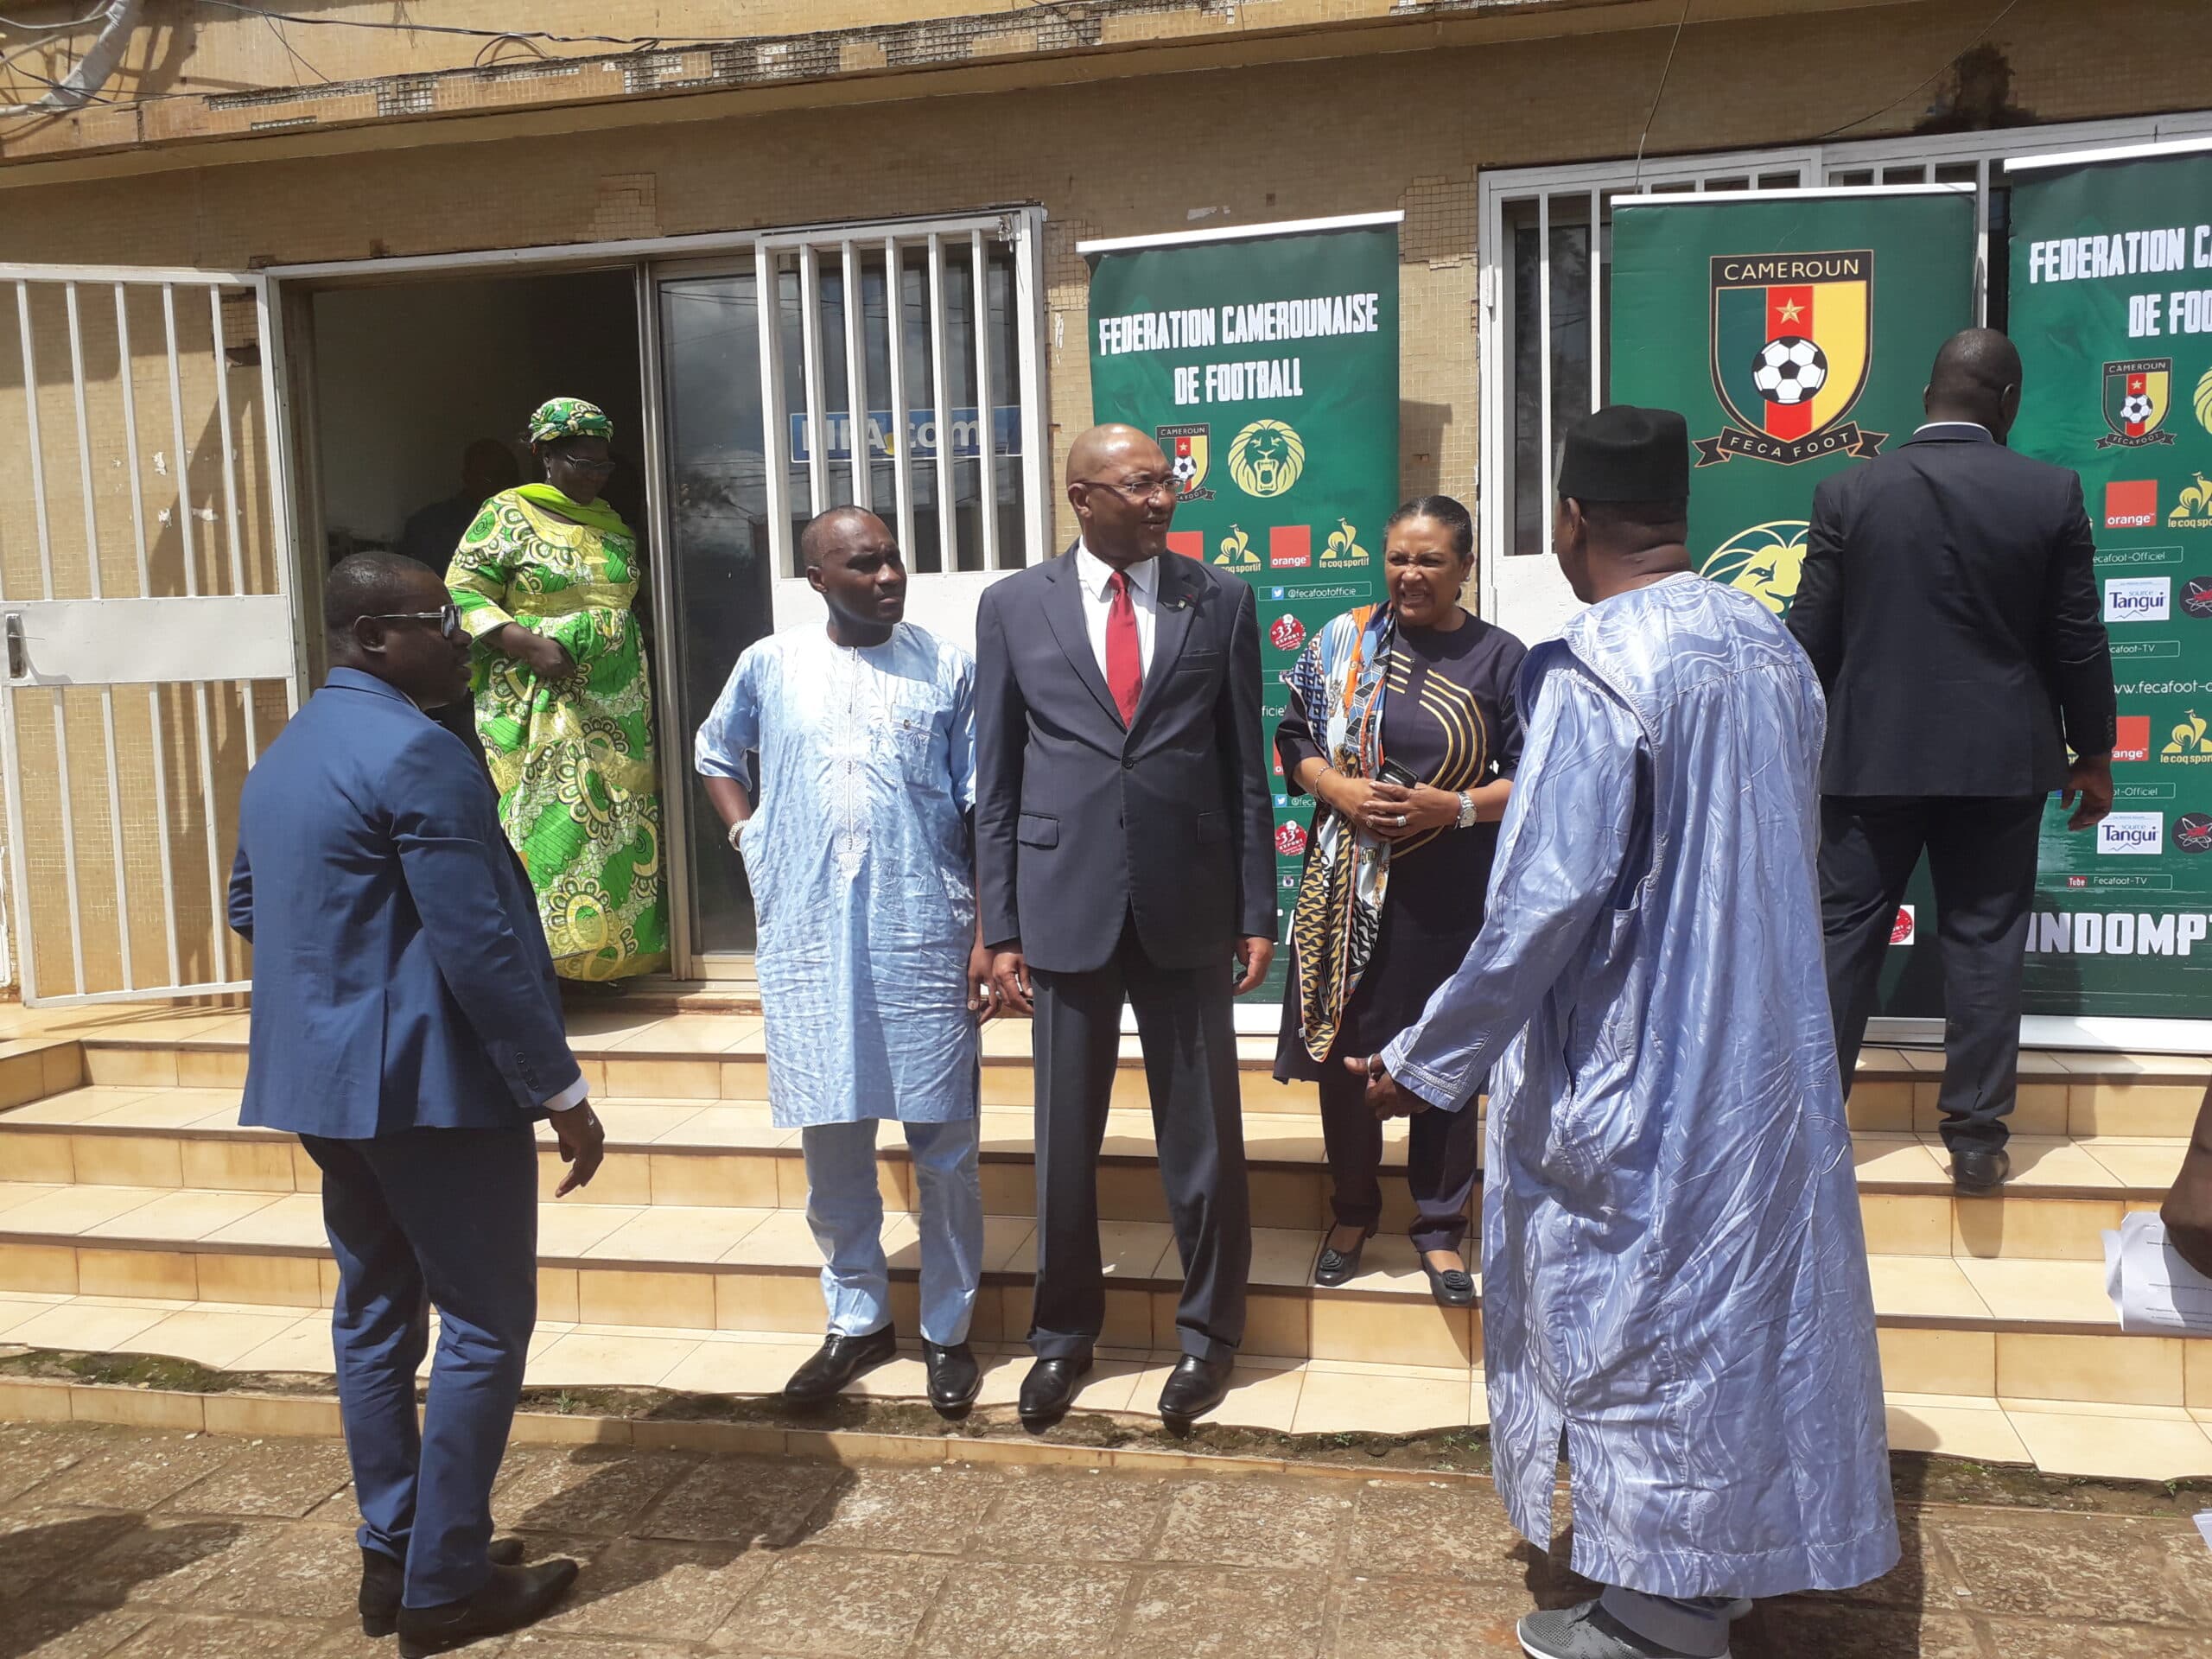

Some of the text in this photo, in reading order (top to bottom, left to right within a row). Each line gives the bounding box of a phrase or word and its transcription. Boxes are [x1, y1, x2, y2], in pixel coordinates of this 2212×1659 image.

[2030, 227, 2185, 283] FEDERATION
[1724, 259, 1859, 280] CAMEROUN
[2128, 294, 2161, 338] DE
[1099, 293, 1378, 356] FEDERATION CAMEROUNAISE
[2108, 362, 2166, 372] CAMEROUN
[1174, 358, 1303, 404] DE FOOTBALL
[1160, 427, 1205, 435] CAMEROUN
[2107, 514, 2151, 525] orange
[1272, 556, 1307, 567] orange
[1343, 557, 1370, 569] sportif
[2093, 551, 2165, 563] ecafoot-Officiel
[1236, 563, 1262, 574] sportif
[2109, 592, 2164, 612] Tangui
[2101, 824, 2156, 845] Tangui
[2069, 876, 2147, 887] Tube Fecafoot-TV
[2024, 912, 2212, 956] INDOMP
